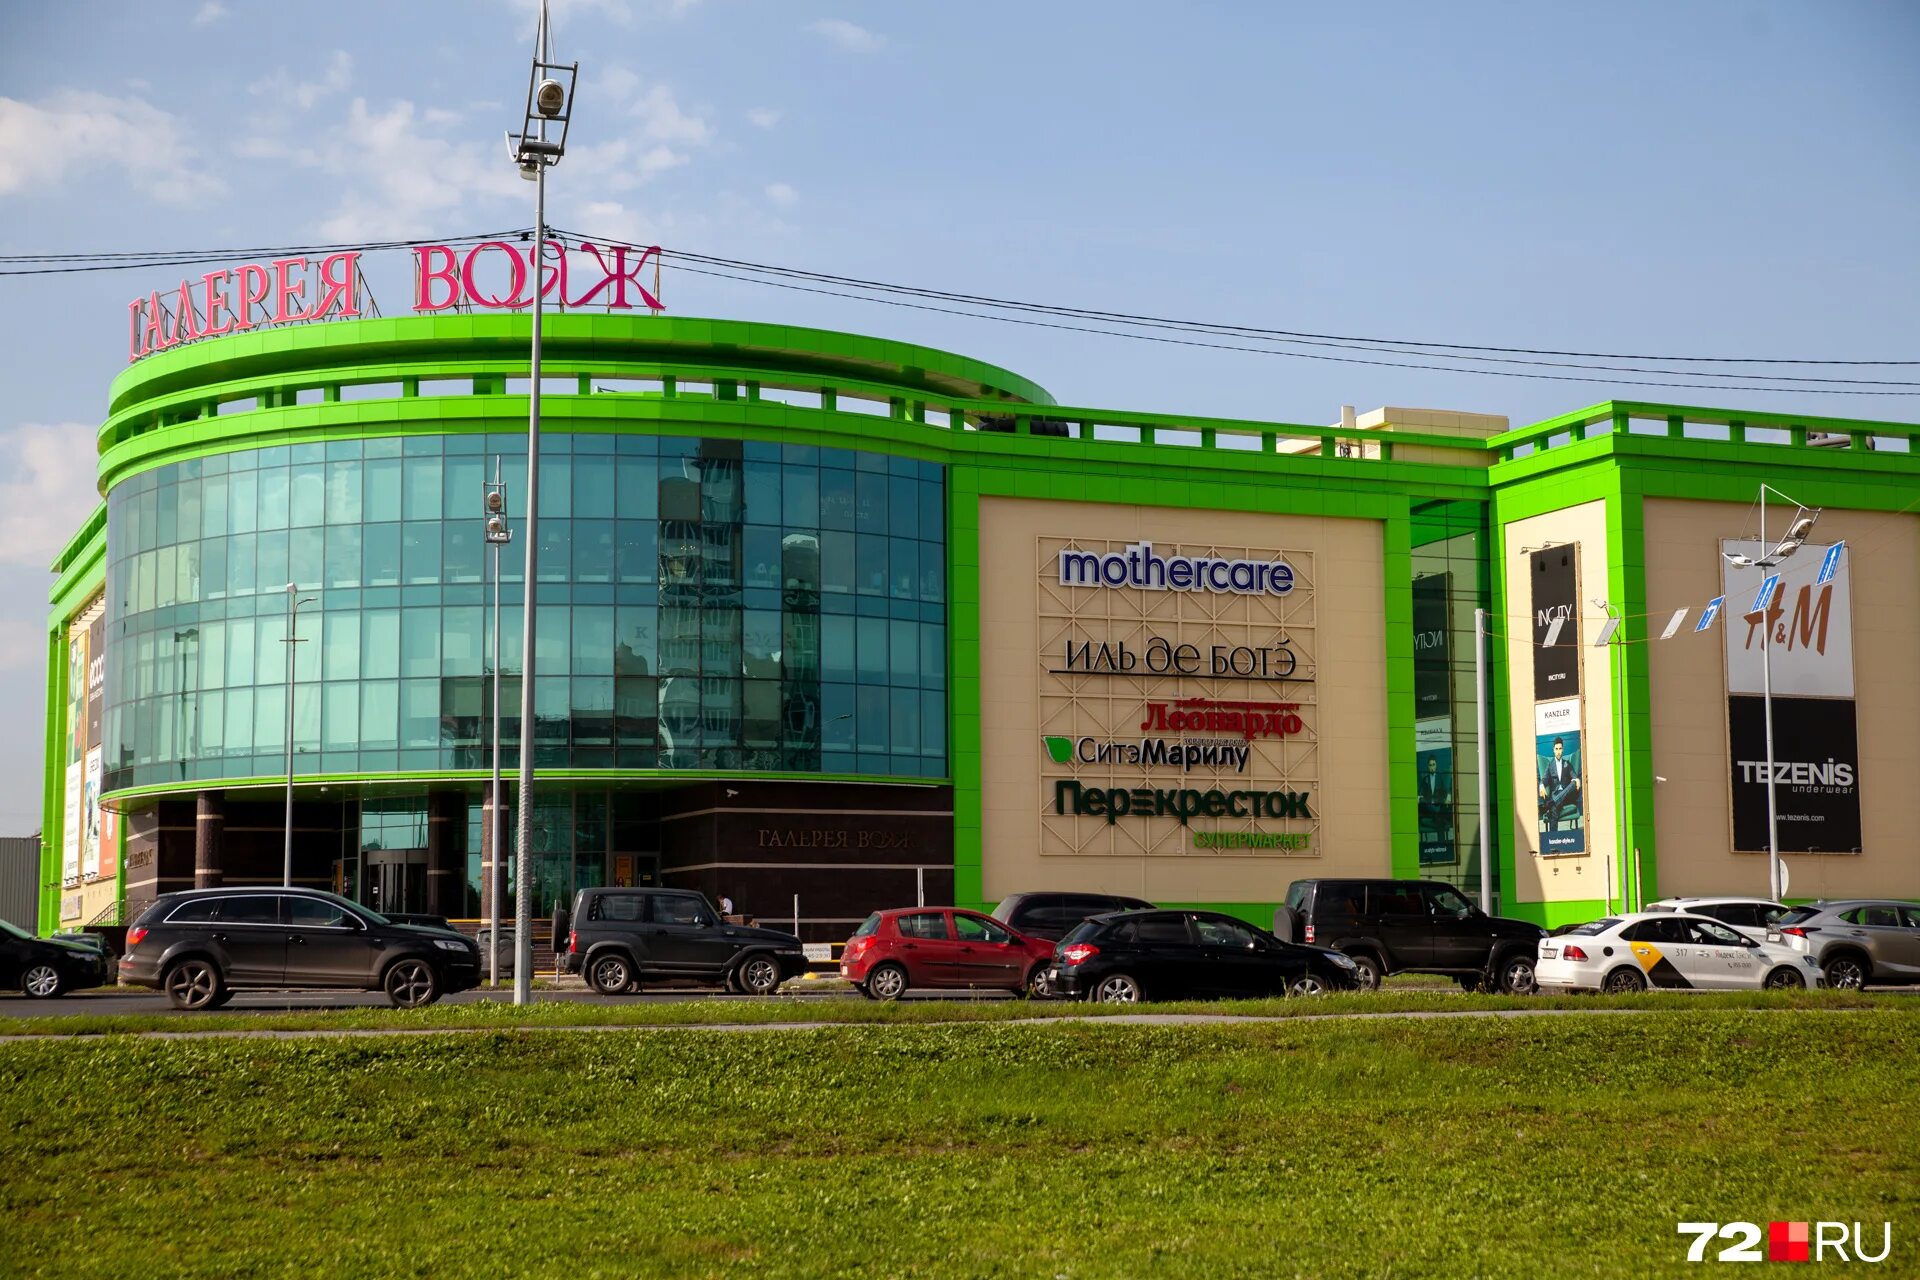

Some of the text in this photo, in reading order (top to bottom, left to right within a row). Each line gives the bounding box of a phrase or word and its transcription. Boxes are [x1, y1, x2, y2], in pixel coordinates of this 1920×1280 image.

[128, 241, 667, 363] ГАЛЕРЕЯ ВОЯЖ
[1061, 544, 1295, 594] mothercare
[1743, 582, 1833, 656] H&M
[1066, 639, 1137, 671] ИЛЬ
[1140, 703, 1303, 741] Леонардо
[1544, 708, 1571, 719] KANZLER
[1075, 737, 1250, 773] СитэМарилу
[1792, 784, 1854, 794] underwear
[1775, 813, 1825, 822] ww.tezenis.com
[758, 829, 849, 848] ГАЛЕРЕЯ
[1193, 831, 1312, 850] СУПЕРМАРКЕТ
[1675, 948, 1688, 957] 317
[1714, 949, 1735, 960] Яндекс
